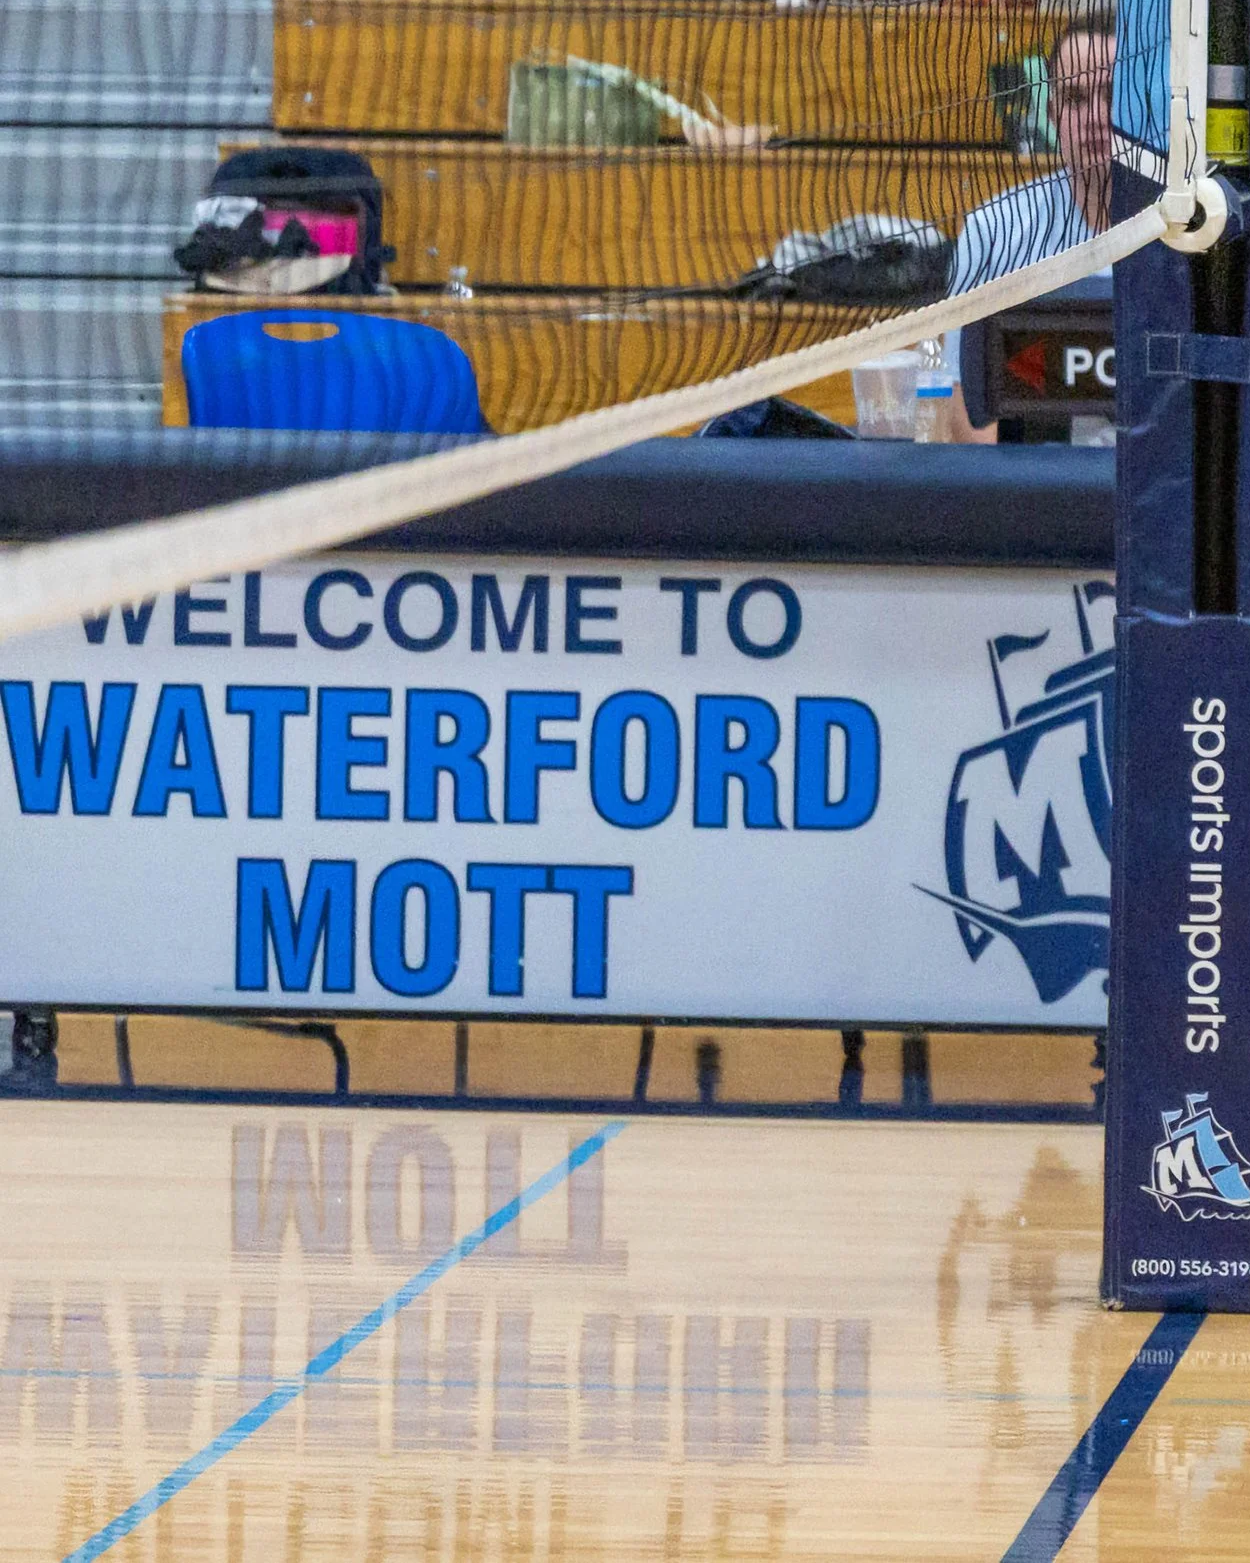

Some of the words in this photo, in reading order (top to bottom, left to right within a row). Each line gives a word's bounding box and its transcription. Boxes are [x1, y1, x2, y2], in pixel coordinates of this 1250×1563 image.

[660, 576, 803, 660] TO
[0, 679, 882, 832] WATERFORD
[1183, 696, 1231, 853] sports
[235, 857, 635, 999] MOTT
[1178, 863, 1227, 1054] imports
[1131, 1259, 1176, 1278] (800)
